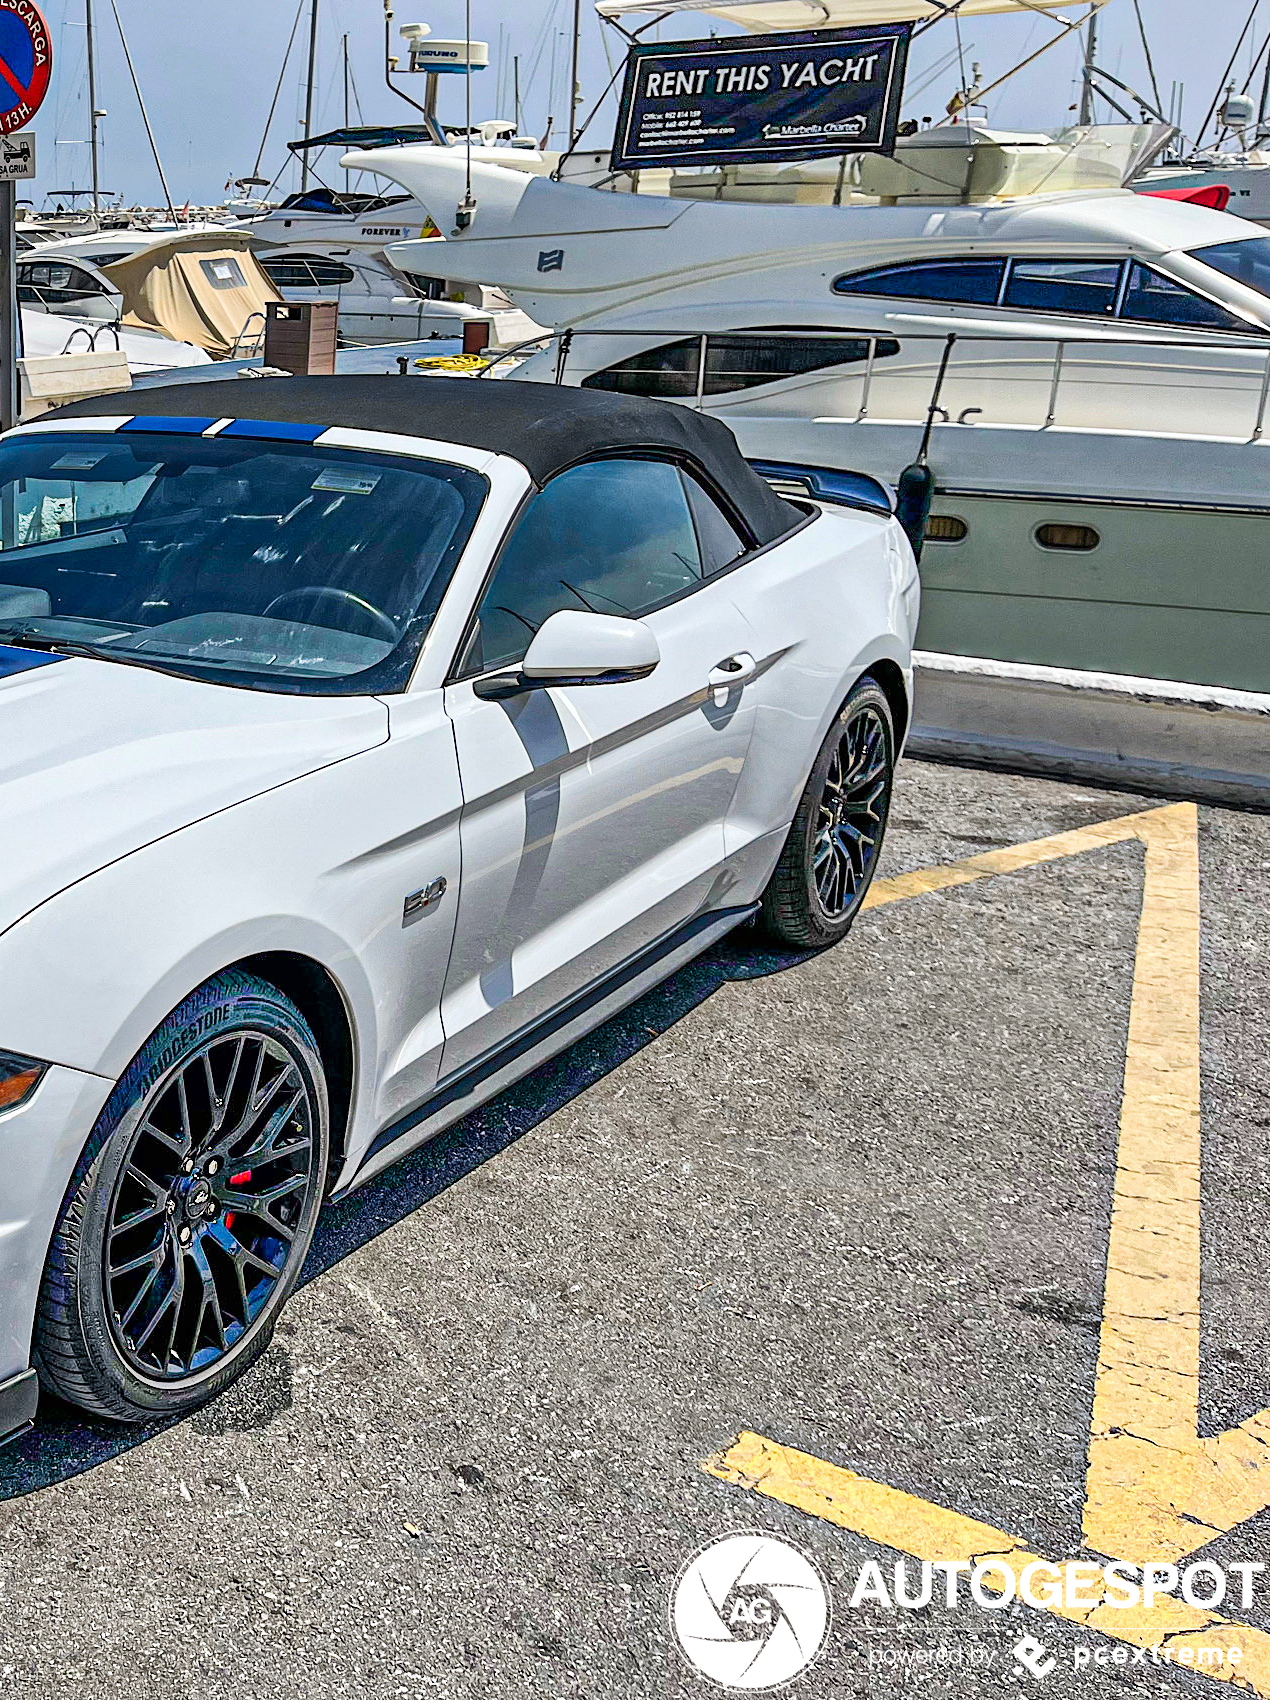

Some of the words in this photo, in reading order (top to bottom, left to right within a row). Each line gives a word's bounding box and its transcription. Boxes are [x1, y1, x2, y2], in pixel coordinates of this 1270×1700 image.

[645, 69, 710, 98] RENT
[715, 65, 771, 93] THIS
[780, 54, 879, 88] YACHT
[5, 115, 20, 129] 13
[780, 125, 822, 135] Marbella
[823, 122, 861, 132] Charter
[8, 163, 29, 174] GRUA
[361, 227, 401, 236] FOREVER
